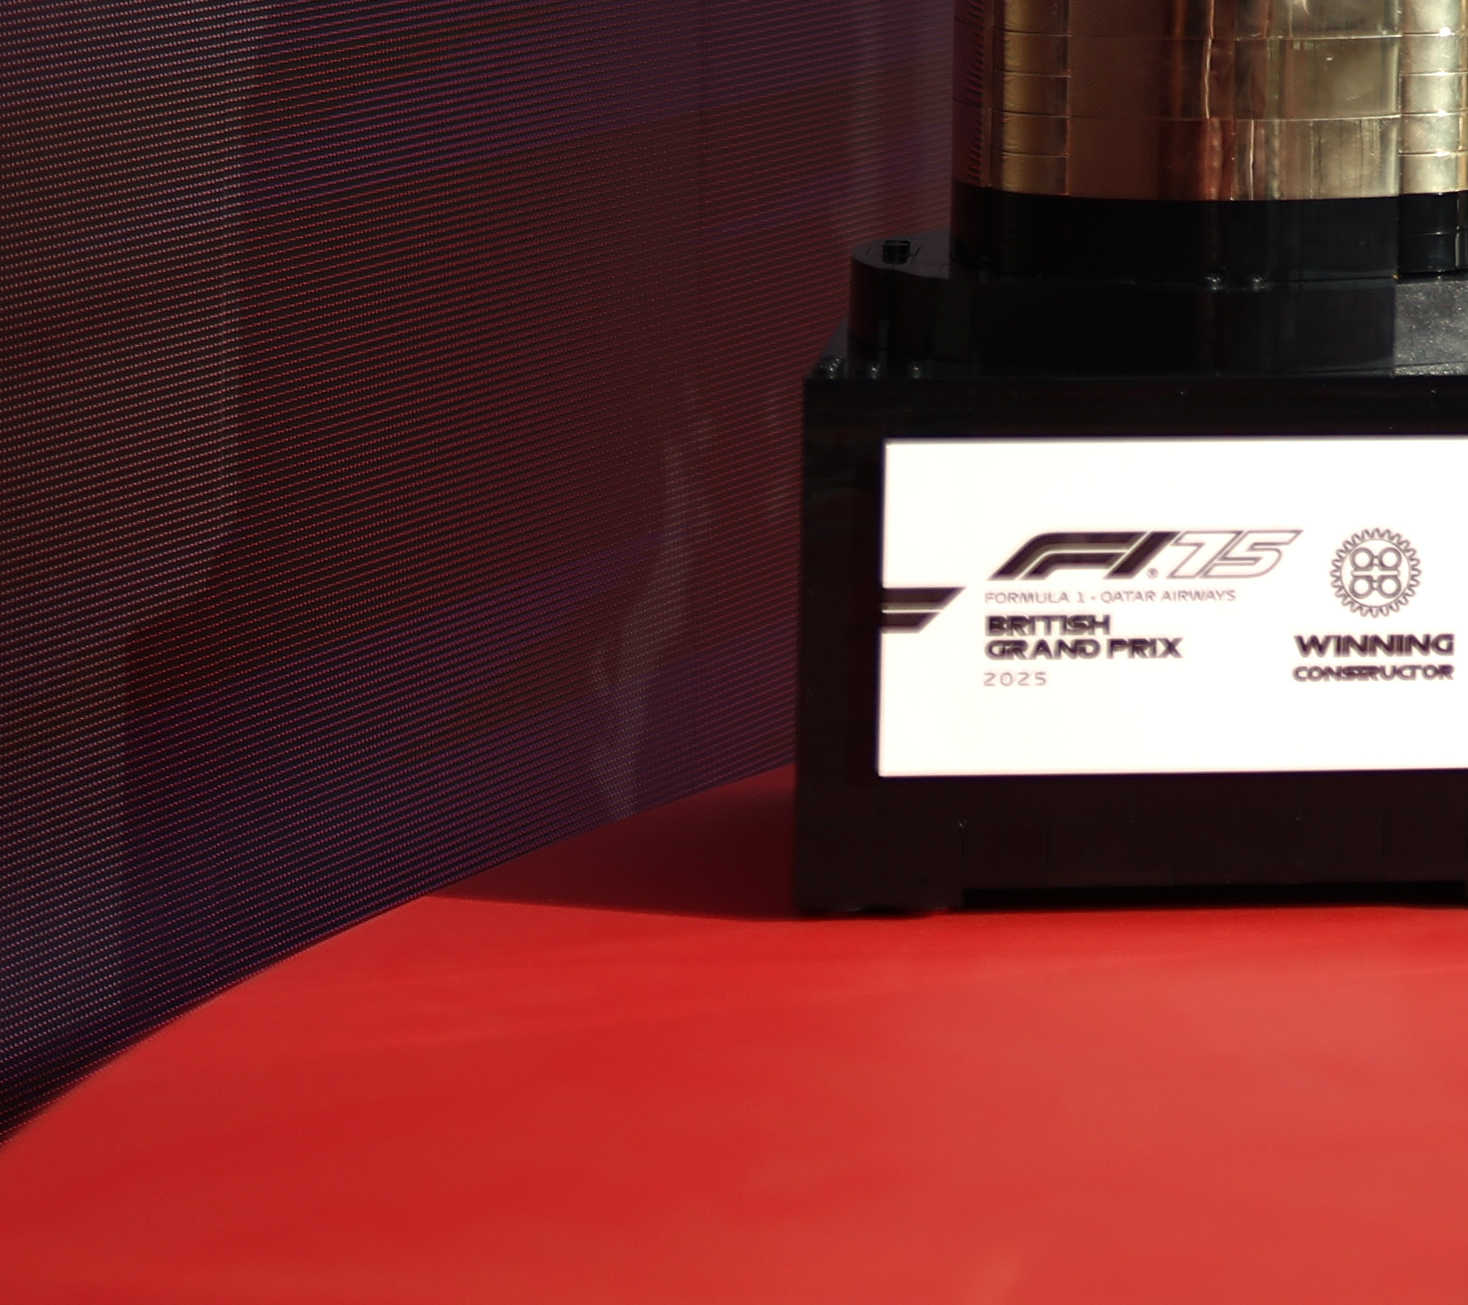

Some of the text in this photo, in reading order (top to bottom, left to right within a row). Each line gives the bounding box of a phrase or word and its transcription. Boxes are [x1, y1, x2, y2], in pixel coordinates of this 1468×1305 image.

[985, 615, 1110, 636] BRITISH
[985, 638, 1183, 660] GRAND PRIX
[1293, 634, 1454, 658] WINNING
[984, 672, 1046, 686] 2025
